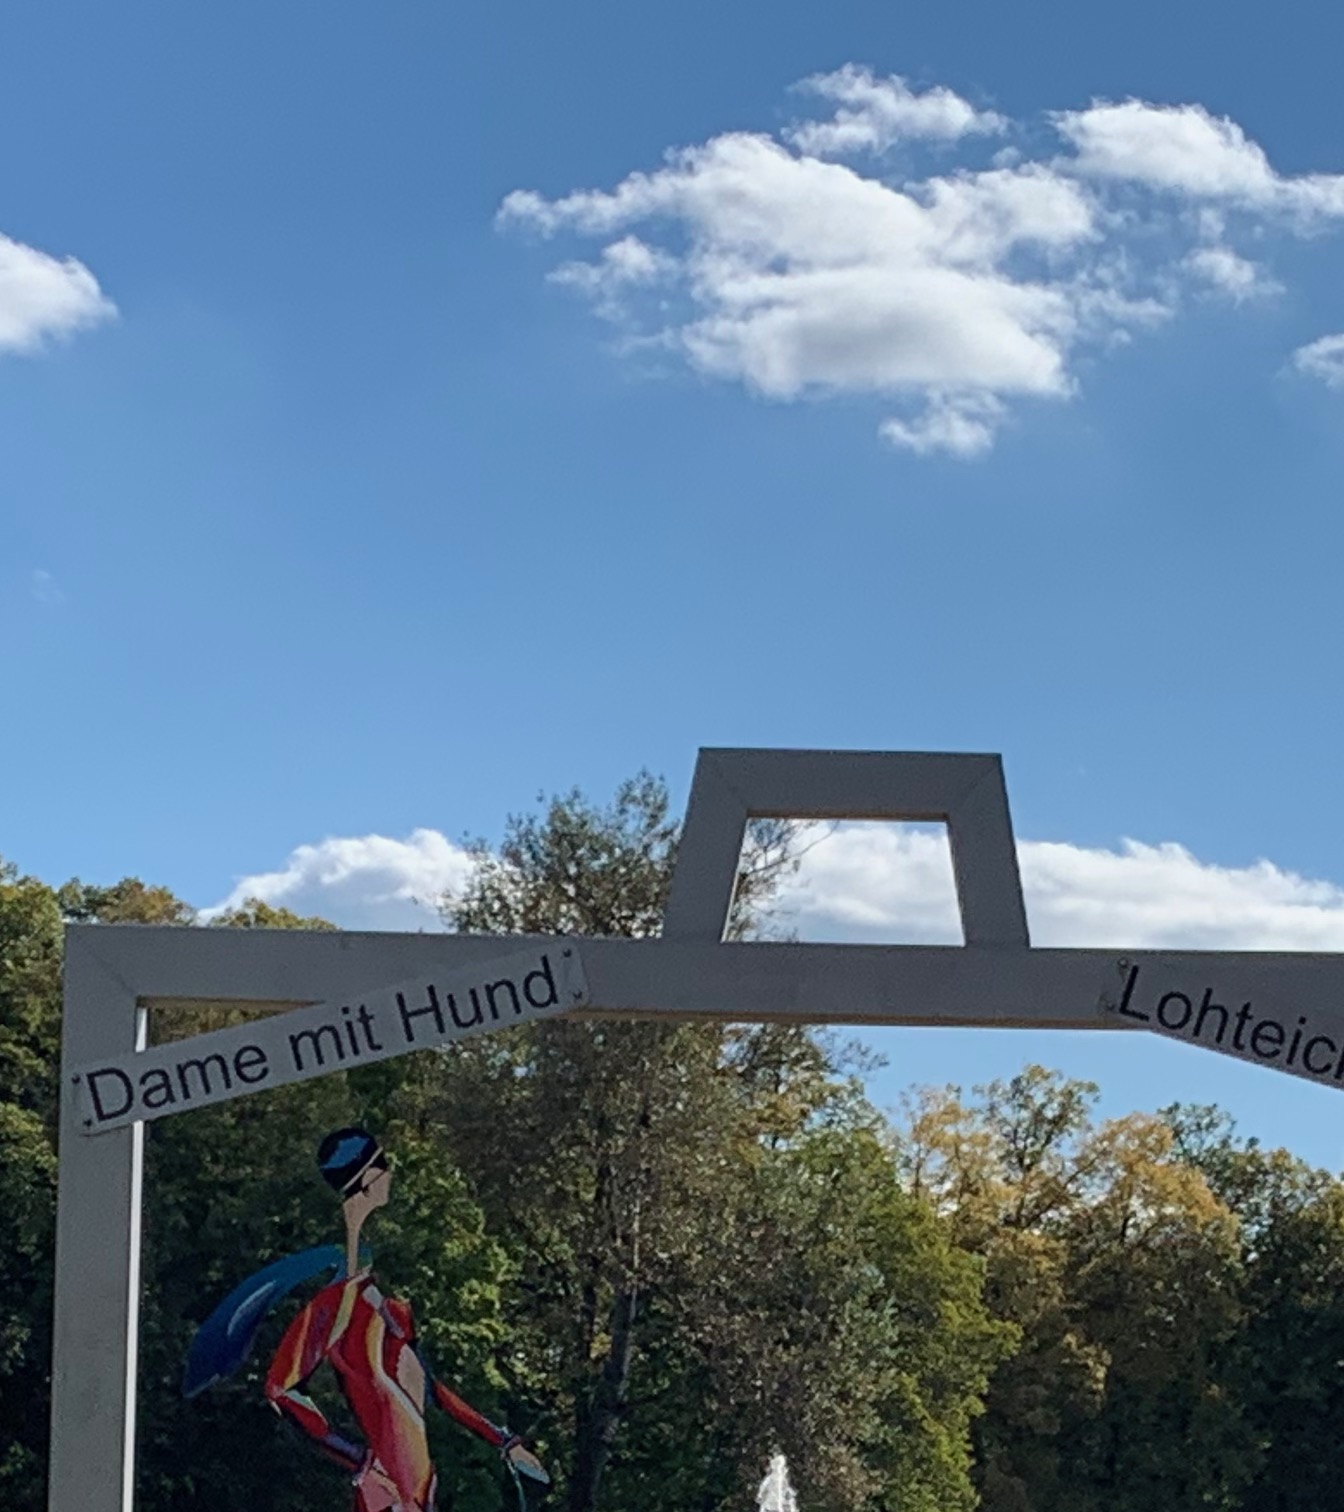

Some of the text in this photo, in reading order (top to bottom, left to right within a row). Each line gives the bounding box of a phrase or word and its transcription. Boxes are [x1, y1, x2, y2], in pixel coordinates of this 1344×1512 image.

[87, 955, 559, 1122] Dame mit Hund
